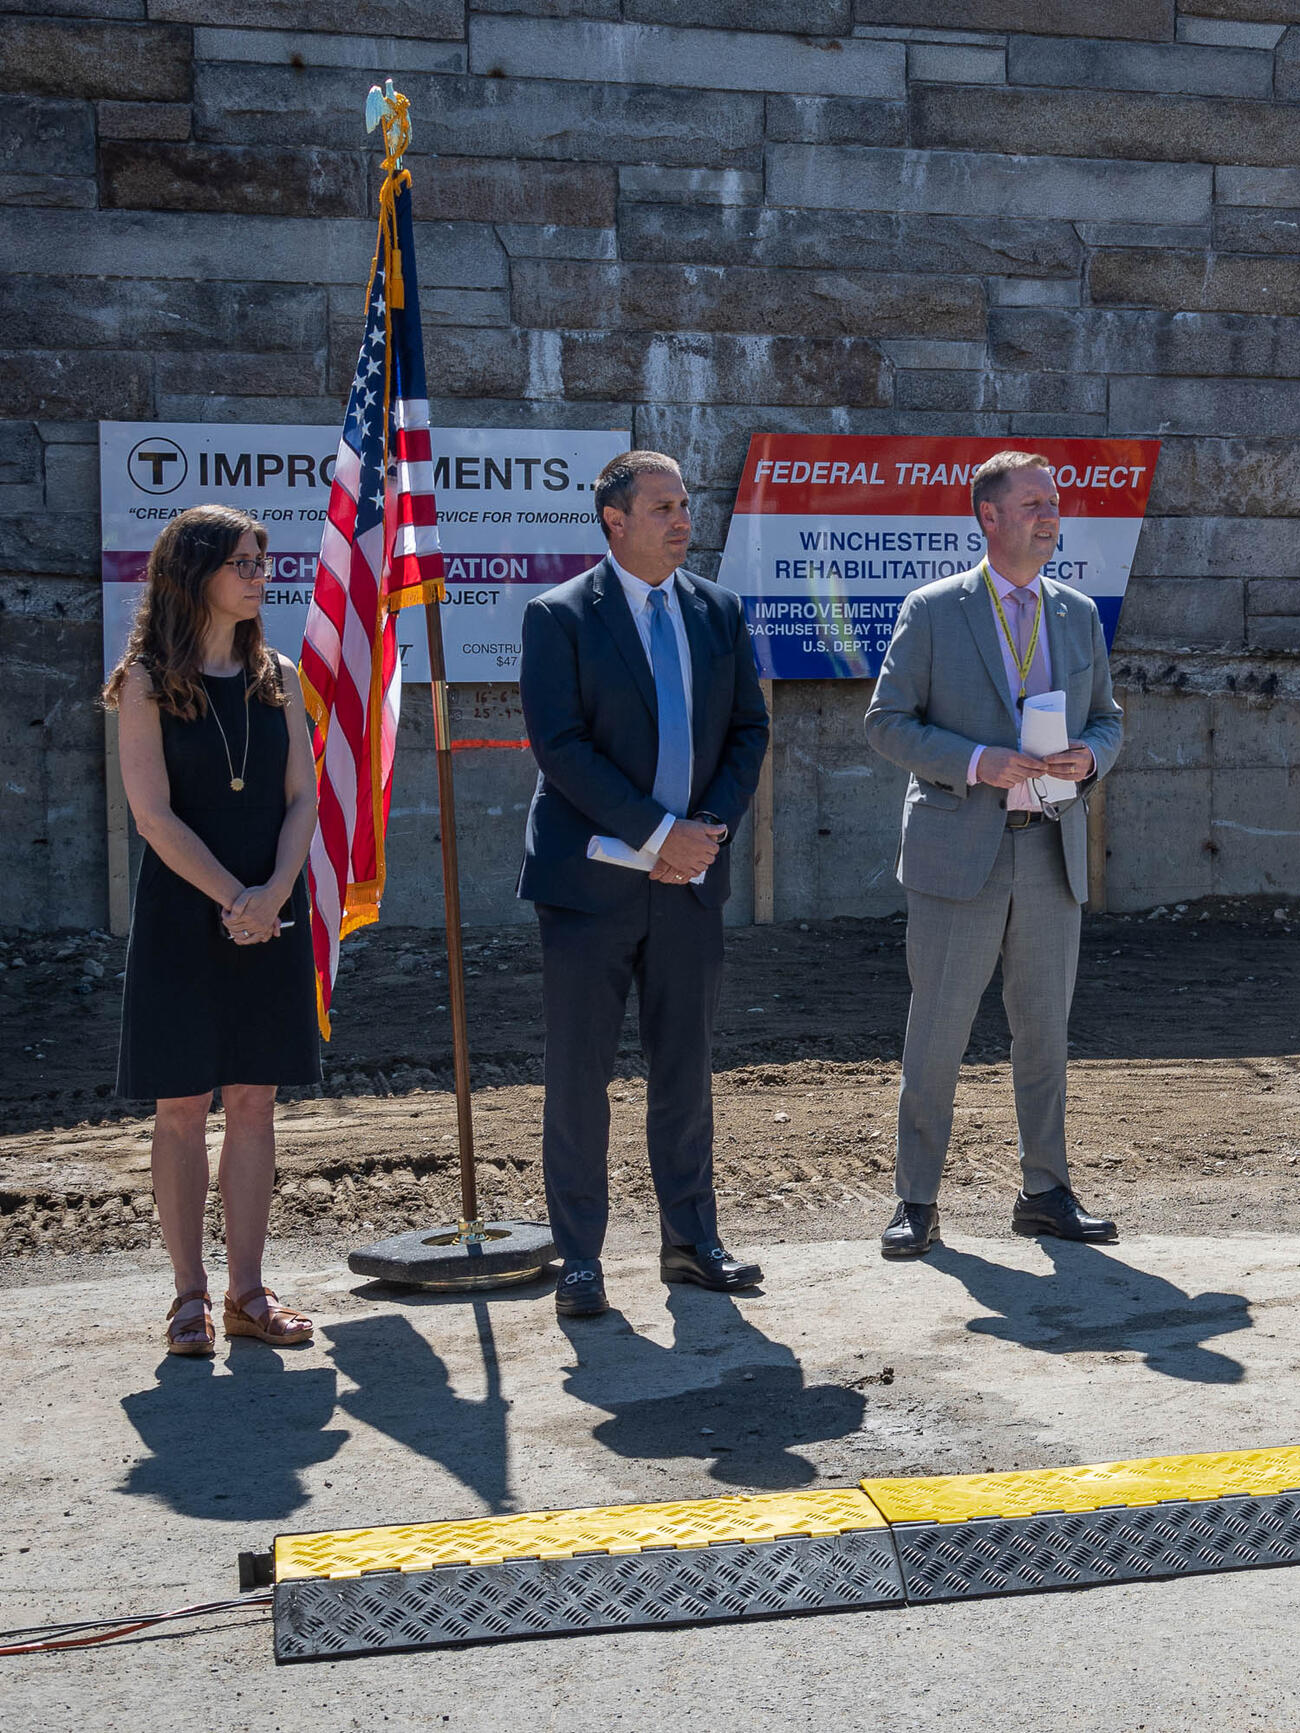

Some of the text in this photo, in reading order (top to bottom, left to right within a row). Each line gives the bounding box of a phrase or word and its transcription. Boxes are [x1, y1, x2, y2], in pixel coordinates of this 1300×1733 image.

[753, 460, 1146, 488] FEDERAL TRANS OJECT
[262, 509, 294, 521] FOR
[298, 509, 327, 522] TOD
[436, 511, 479, 523] RVICE
[482, 511, 512, 523] FOR
[800, 531, 959, 552] WINCHESTER
[444, 557, 528, 579] ATION
[775, 559, 972, 580] REHABILITATION
[440, 590, 500, 605] OJECT
[747, 623, 840, 636] SACHUSETTS
[843, 623, 871, 636] BAY
[462, 643, 522, 655] CONSTRU
[803, 640, 829, 653] U.S.
[833, 640, 872, 653] DEPT.
